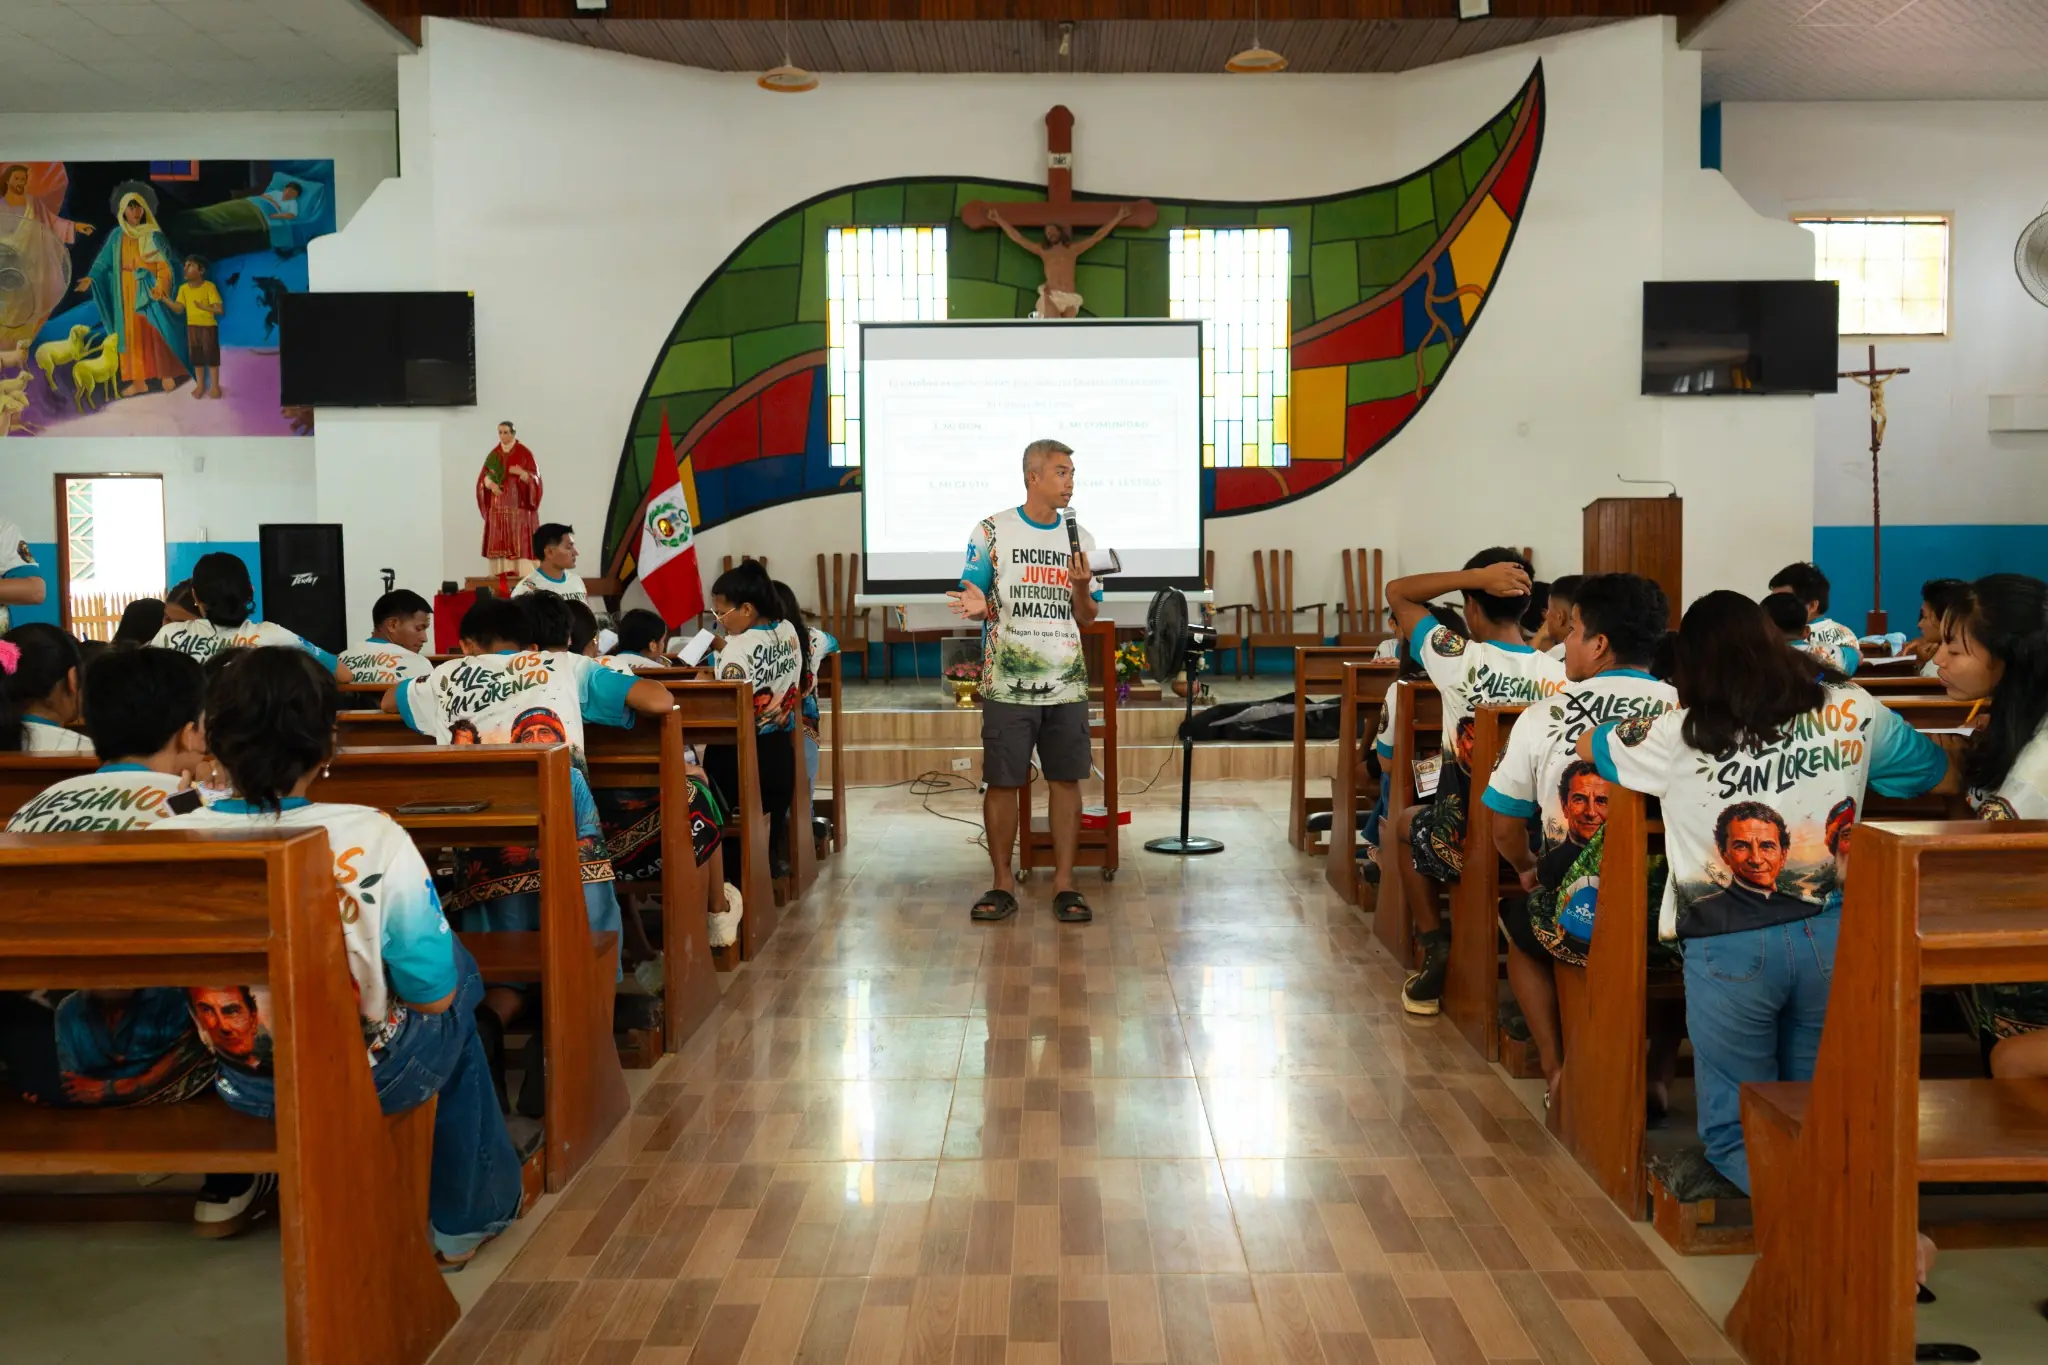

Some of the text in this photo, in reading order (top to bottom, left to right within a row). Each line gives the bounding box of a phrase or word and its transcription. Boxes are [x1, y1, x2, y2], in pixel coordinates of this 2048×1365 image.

[1012, 548, 1071, 568] ENCUENT
[1012, 601, 1071, 620] AMAZÓNI
[1717, 739, 1863, 799] SAN LORENZO
